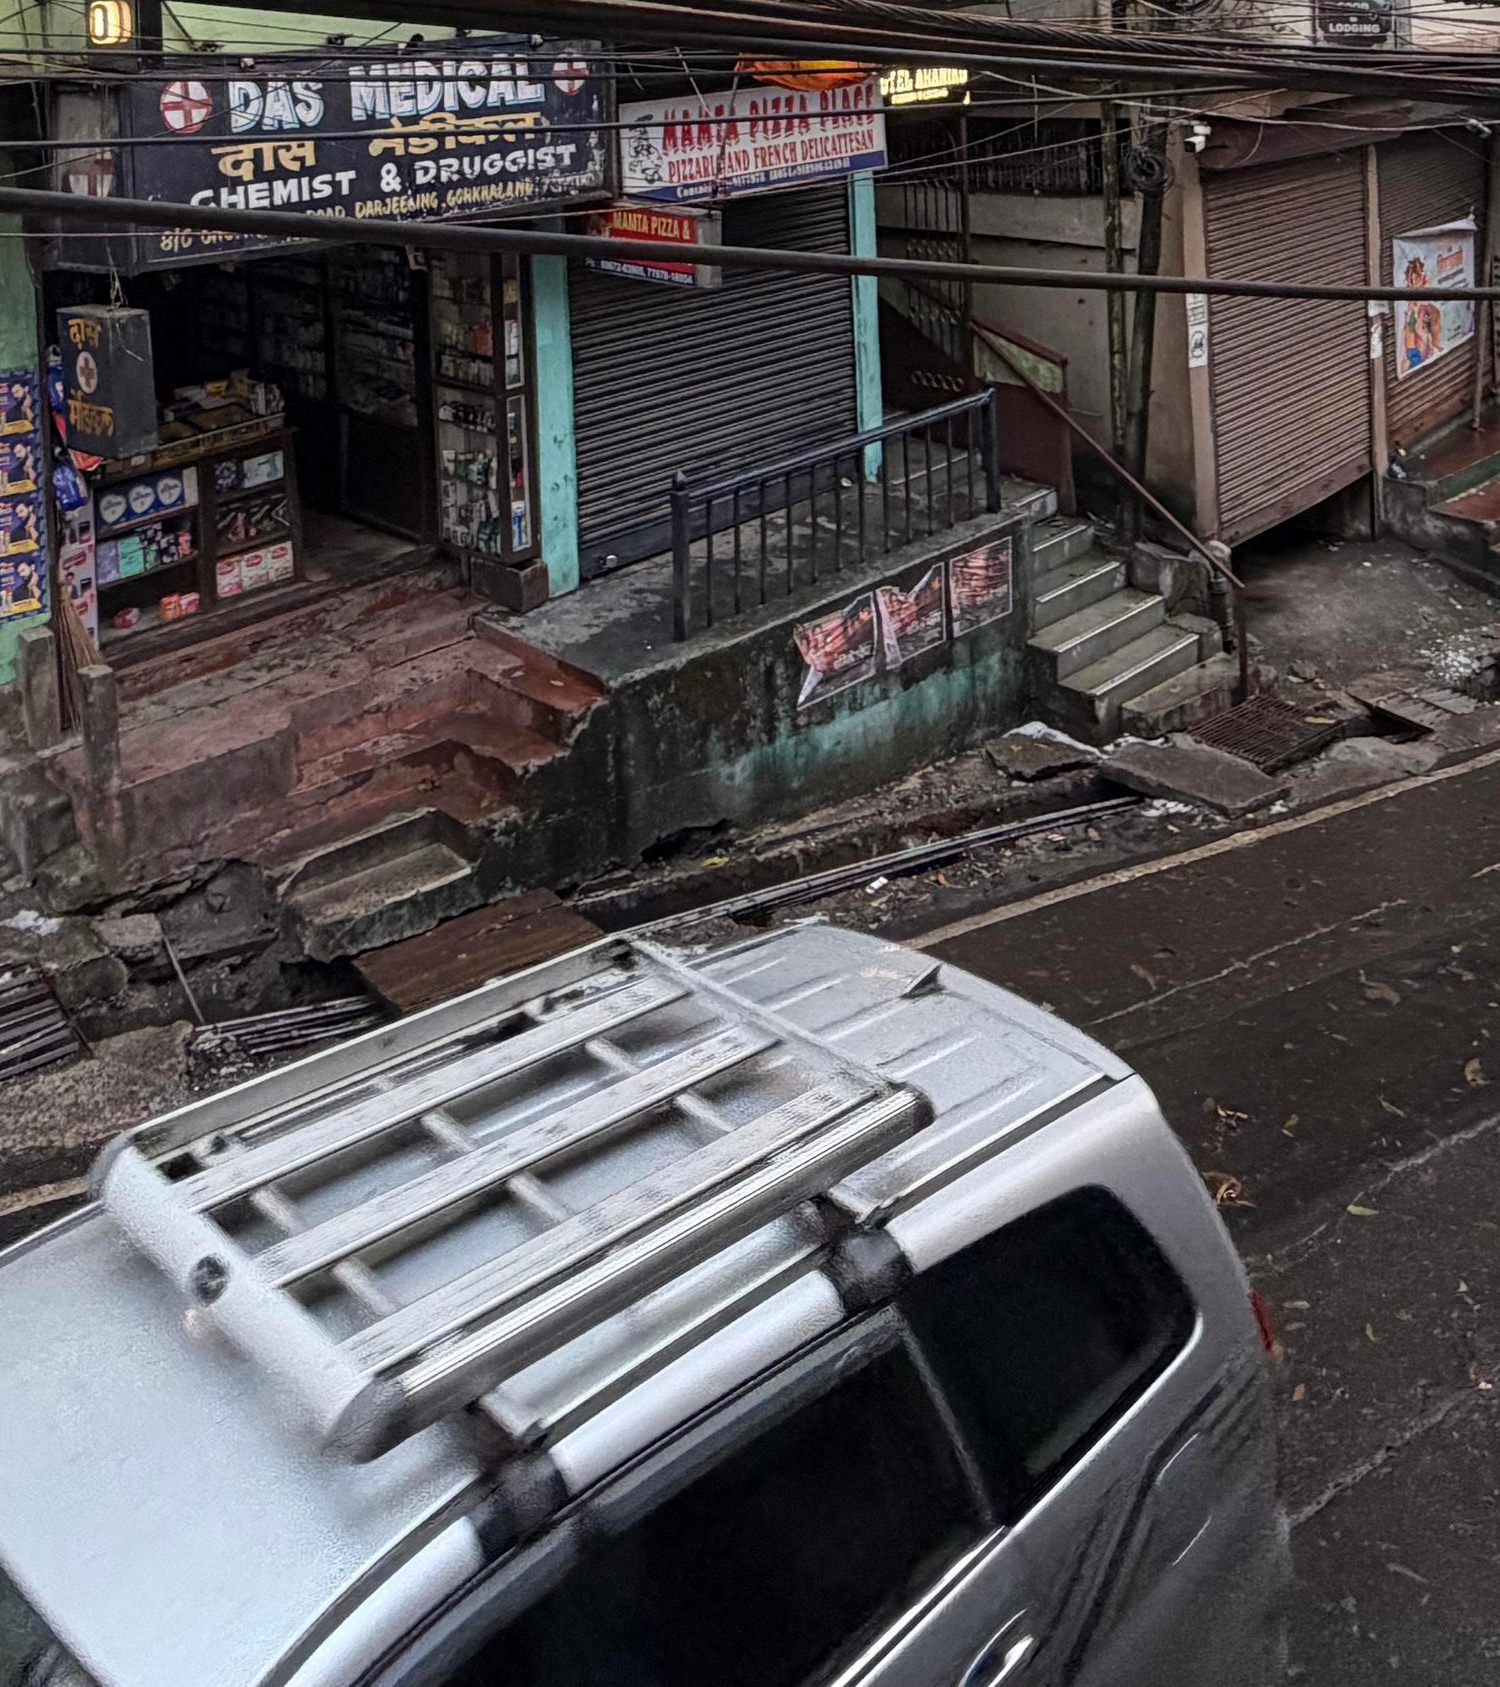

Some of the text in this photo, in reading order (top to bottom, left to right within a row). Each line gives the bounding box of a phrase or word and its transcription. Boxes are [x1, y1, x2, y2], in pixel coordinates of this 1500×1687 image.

[1328, 23, 1381, 33] LODGING
[228, 54, 546, 133] DAS MEDICAL
[663, 103, 740, 156] MAMTA
[750, 94, 812, 143] PIZZA
[190, 170, 357, 210] CHEMIST
[380, 162, 401, 192] &
[414, 144, 577, 185] DRUGGIST
[211, 140, 317, 182] दास
[668, 154, 725, 184] PIZZARI
[754, 140, 797, 170] FRENCH
[612, 212, 691, 240] MAMTA PIZZA &
